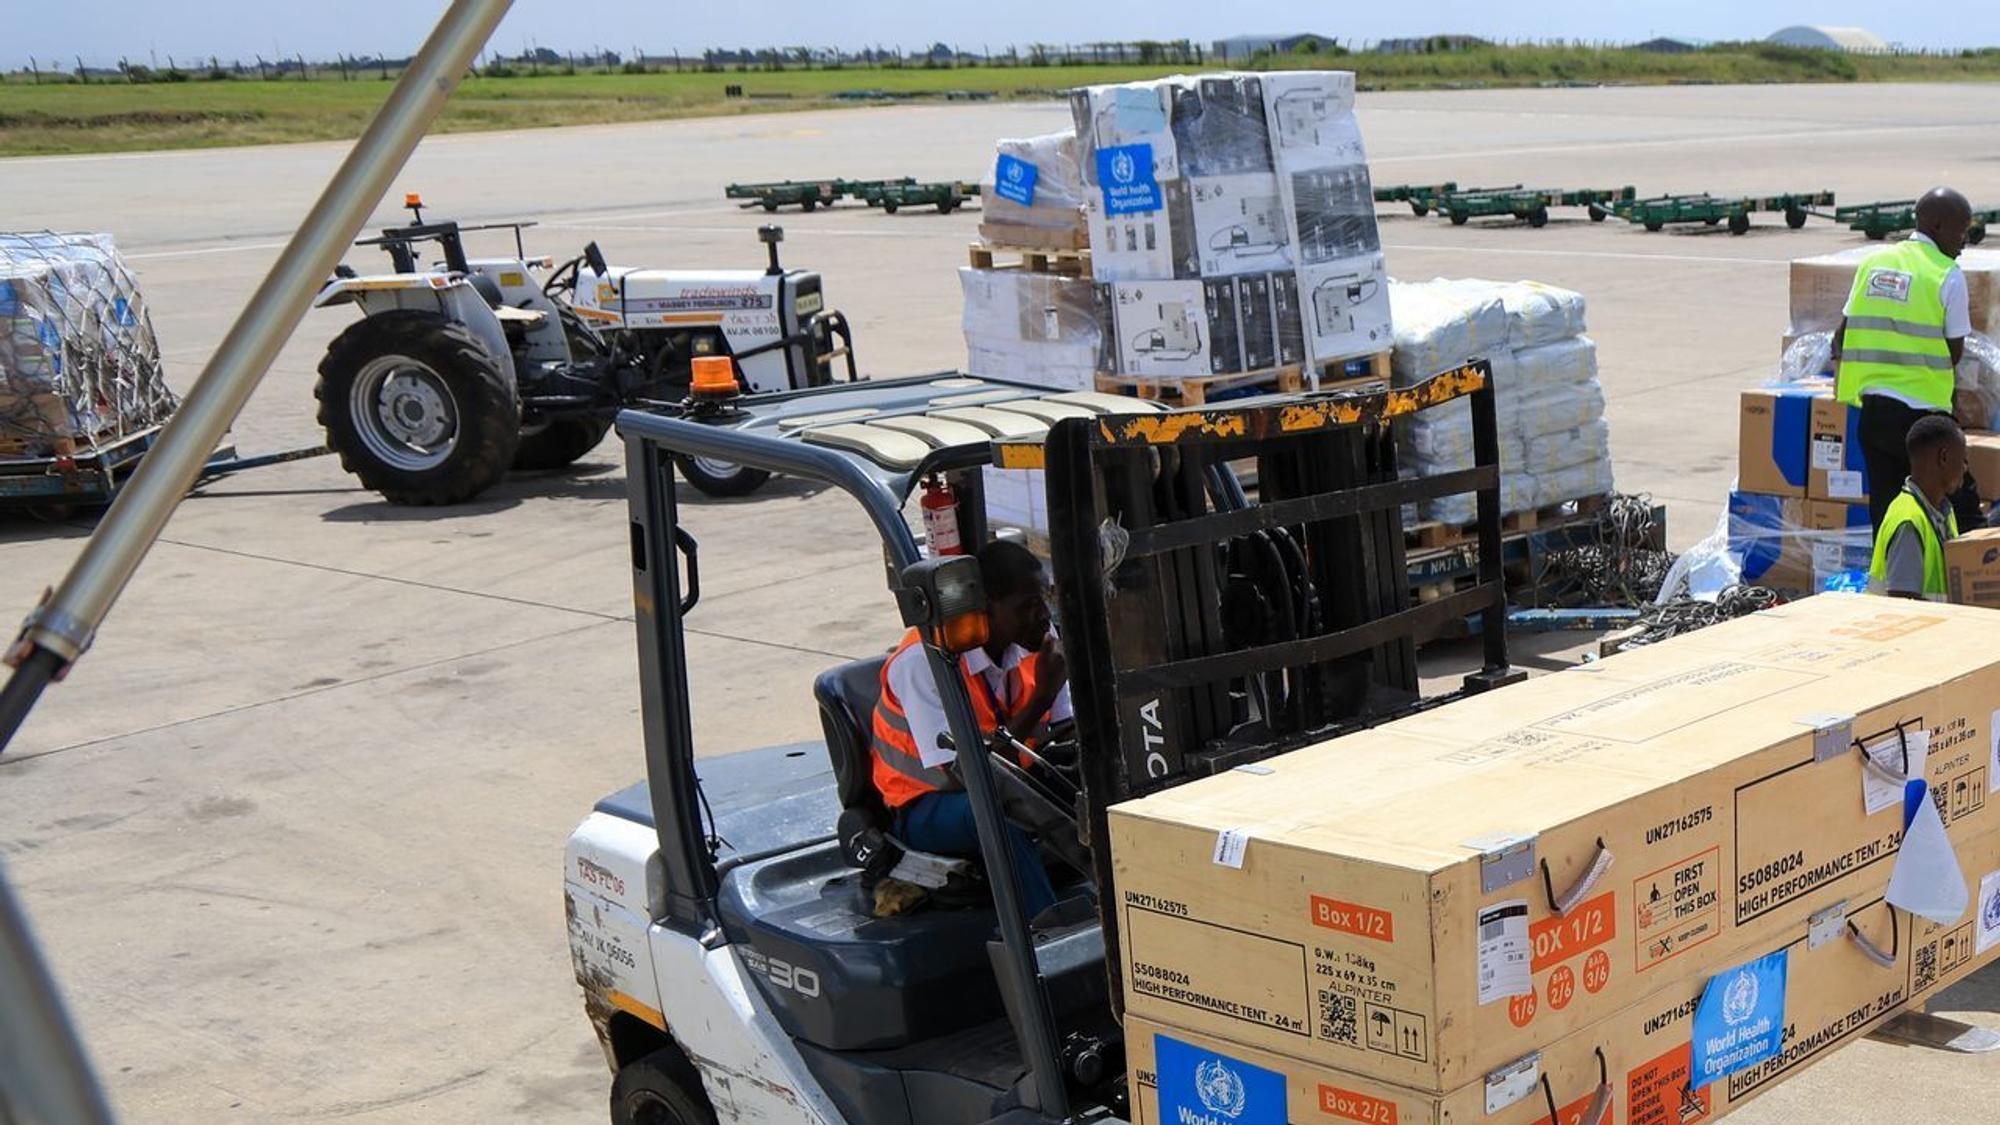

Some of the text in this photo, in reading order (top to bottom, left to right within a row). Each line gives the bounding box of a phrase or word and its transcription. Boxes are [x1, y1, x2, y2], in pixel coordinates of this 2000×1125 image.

[740, 297, 763, 308] 275
[1646, 805, 1713, 844] UN27162575
[1674, 861, 1704, 887] FIRST
[1738, 896, 1769, 919] HIGH
[1770, 852, 1853, 907] PERFORMANCE
[1855, 840, 1881, 864] TENT
[1739, 850, 1804, 894] S5088024
[1124, 890, 1189, 916] UN27162575
[1674, 881, 1700, 902] OPEN
[1674, 890, 1717, 919] THIS BOX
[1318, 902, 1386, 935] Box 1/2
[1571, 909, 1604, 945] 1/2
[768, 957, 820, 998] 30
[1134, 961, 1190, 986] S5088024
[1316, 962, 1334, 977] 225
[1344, 969, 1356, 981] 69
[1366, 975, 1378, 988] 35
[1381, 980, 1397, 992] cm
[1586, 965, 1607, 989] 3/6
[1134, 978, 1161, 996] HIGH
[1162, 983, 1239, 1015] PERFORMANCE
[1240, 1003, 1268, 1022] TENT
[1274, 1013, 1290, 1029] 24
[1328, 980, 1393, 1004] ALPINTER
[1551, 980, 1572, 1005] 2/6
[1512, 996, 1536, 1021] 1/6
[1705, 1016, 1771, 1056] World Health
[1731, 1066, 1761, 1095] HIGH
[1763, 1019, 1844, 1077] PERFORMANCE
[1846, 1003, 1871, 1032] TENT
[1877, 992, 1890, 1013] 24
[1704, 1037, 1770, 1077] Organization
[1631, 1076, 1642, 1089] DO
[1325, 1091, 1390, 1123] Box 2/2
